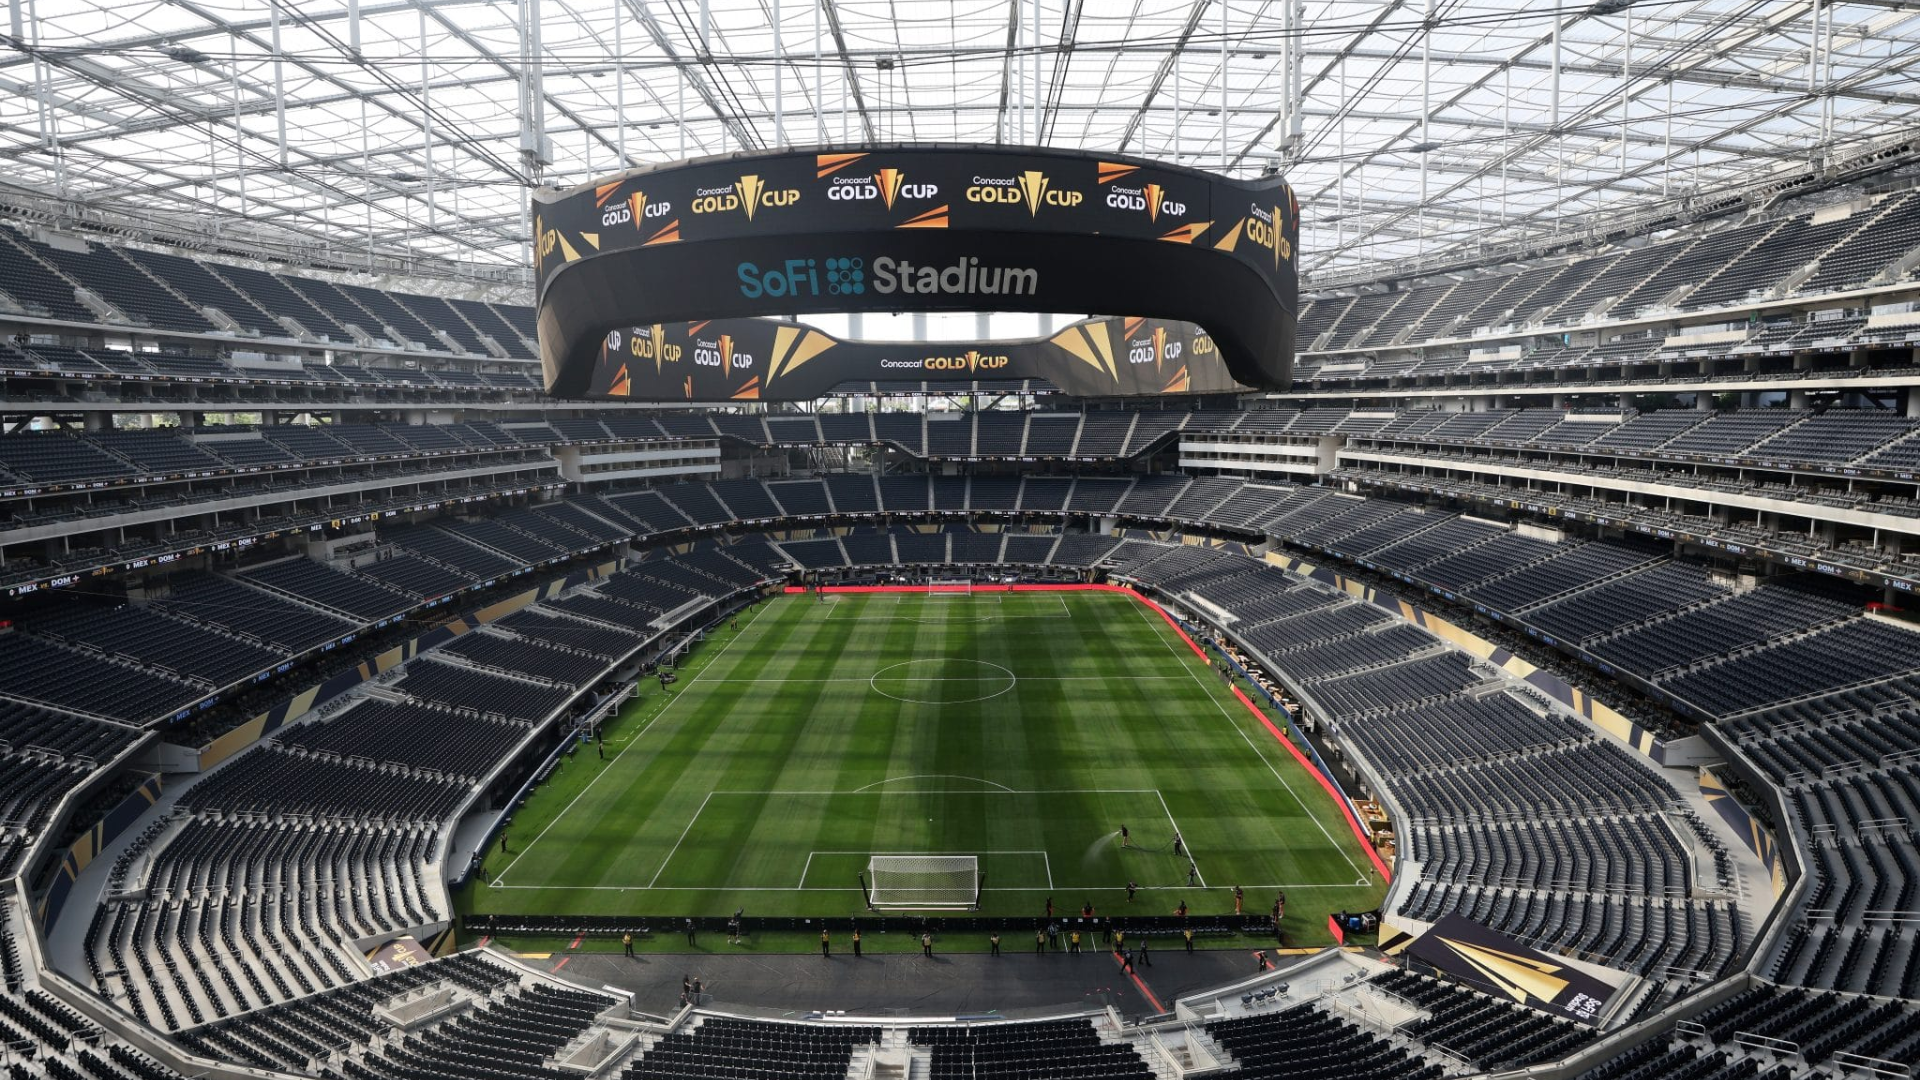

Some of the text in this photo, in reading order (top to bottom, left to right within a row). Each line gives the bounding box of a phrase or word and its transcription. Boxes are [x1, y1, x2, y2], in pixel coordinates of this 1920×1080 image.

[833, 176, 871, 185] Concacaf
[973, 176, 1015, 186] Concacaf
[696, 185, 732, 197] Concacaf
[828, 184, 938, 200] GOLD CUP
[966, 186, 1083, 207] GOLD CUP
[1111, 185, 1142, 196] Concacaf
[605, 202, 626, 212] Concacaf
[692, 189, 800, 214] GOLD CUP
[1106, 194, 1186, 217] GOLD CUP
[602, 202, 670, 226] GOLD CUP
[1251, 202, 1272, 222] Concacaf
[542, 229, 556, 257] CUP
[1247, 218, 1290, 262] GOLD CUP
[737, 256, 1038, 298] SoFi Stadium
[631, 337, 682, 362] GOLD CUP
[1130, 342, 1181, 364] GOLD CUP
[1193, 336, 1212, 355] GOLD
[694, 349, 752, 368] GOLD CUP
[881, 356, 1008, 370] Concacaf GOLD CUP
[133, 560, 148, 569] MEX
[158, 554, 174, 562] DOM
[1791, 557, 1806, 566] MEX
[1817, 564, 1834, 573] DOM
[18, 583, 38, 594] MEX
[51, 576, 71, 586] DOM
[1893, 581, 1911, 591] MEX
[258, 671, 270, 680] MEX
[176, 699, 214, 720] MEX DOM
